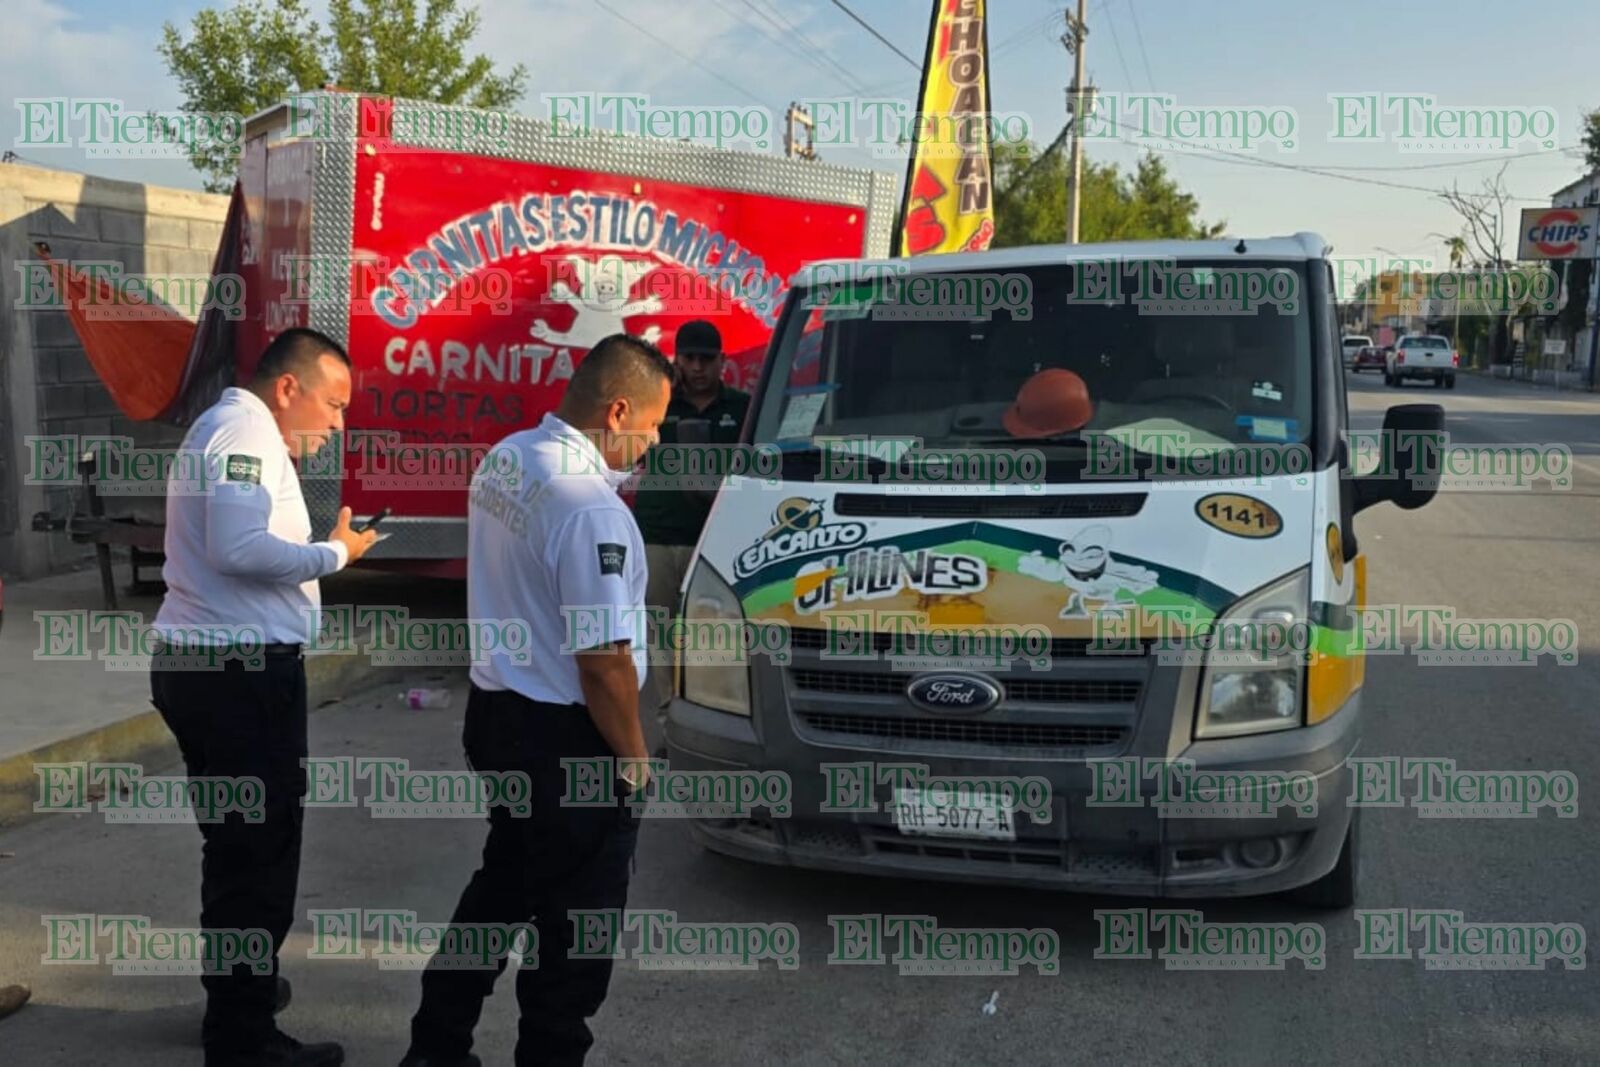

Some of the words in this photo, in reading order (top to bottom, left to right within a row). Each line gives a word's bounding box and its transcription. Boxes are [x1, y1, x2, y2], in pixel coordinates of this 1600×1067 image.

[1528, 223, 1592, 243] CHIPS
[371, 193, 547, 329] CARNITAS
[551, 190, 658, 250] ESTILO
[384, 336, 574, 386] CARNITA
[1206, 501, 1267, 530] 1141
[741, 523, 863, 571] ENCANTO
[926, 681, 976, 705] Ford
[900, 803, 1010, 832] RH-5077-A
